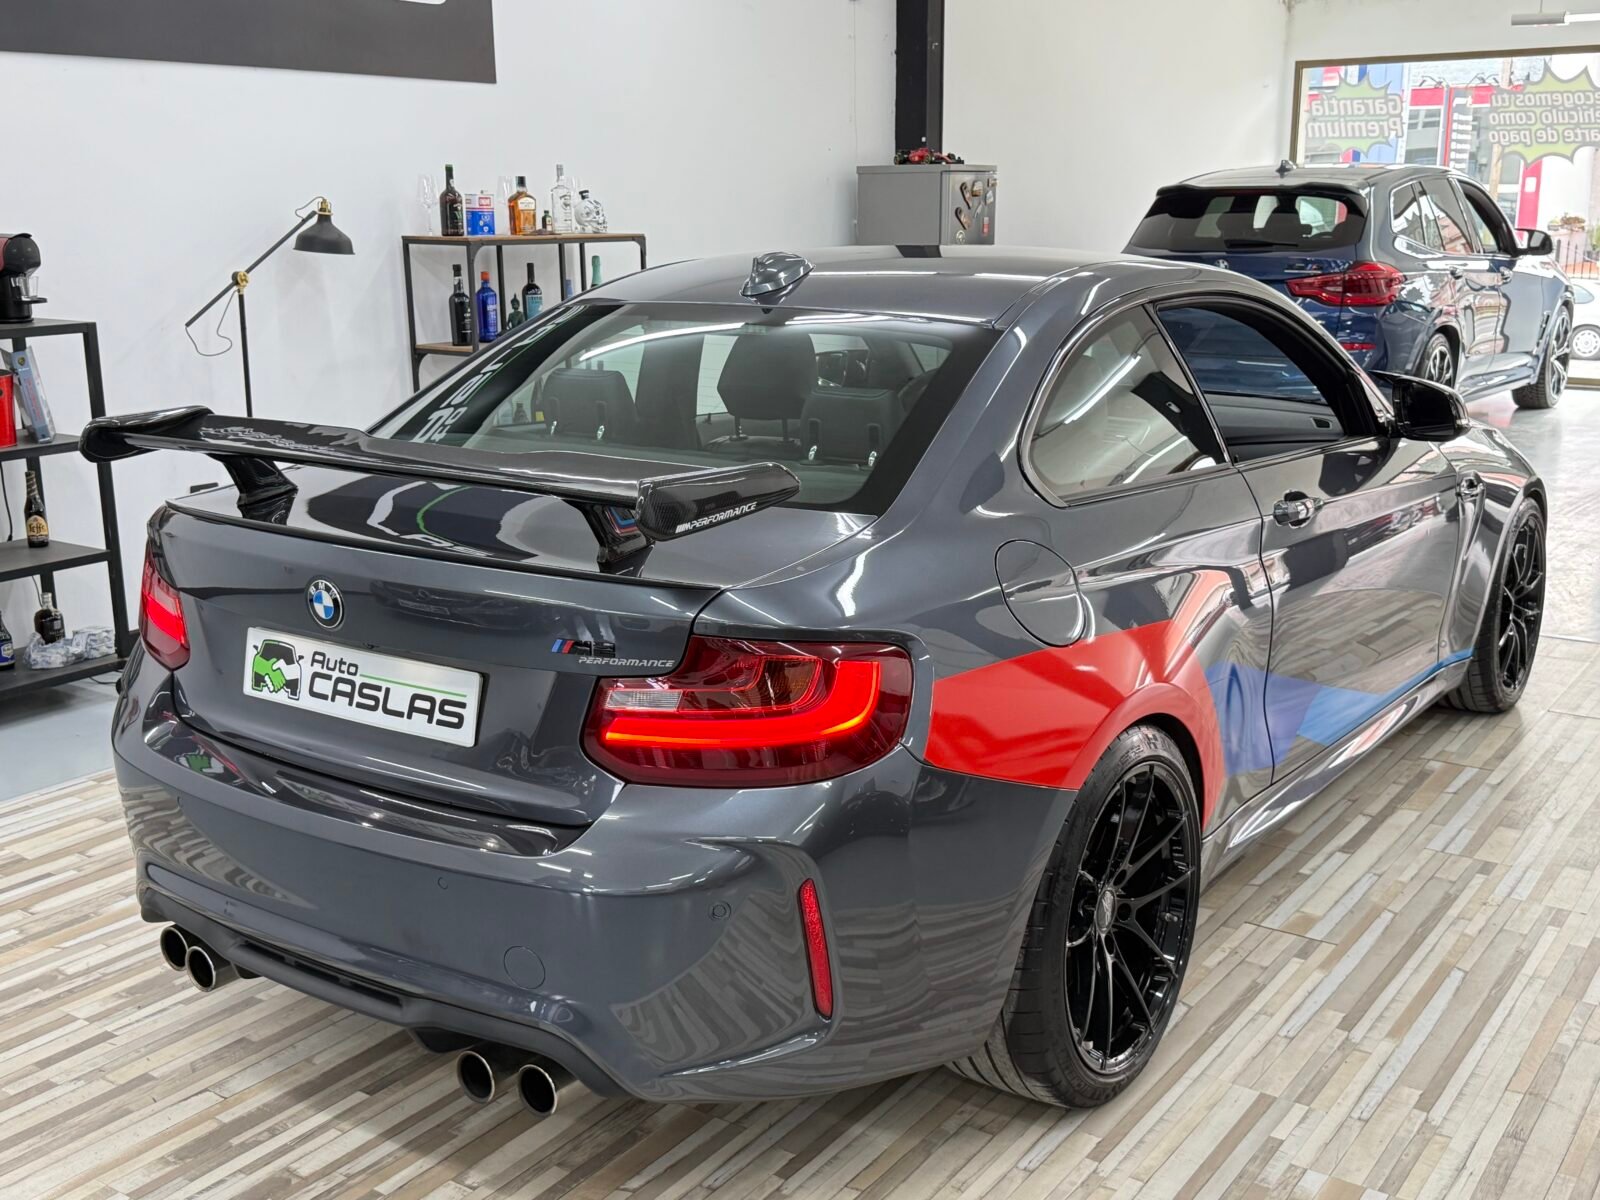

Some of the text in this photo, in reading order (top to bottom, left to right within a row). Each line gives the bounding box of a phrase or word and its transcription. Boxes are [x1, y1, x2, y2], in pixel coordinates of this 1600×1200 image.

[310, 650, 359, 677] Auto
[578, 655, 675, 668] PERFORMANCE
[308, 671, 467, 730] CASLAS
